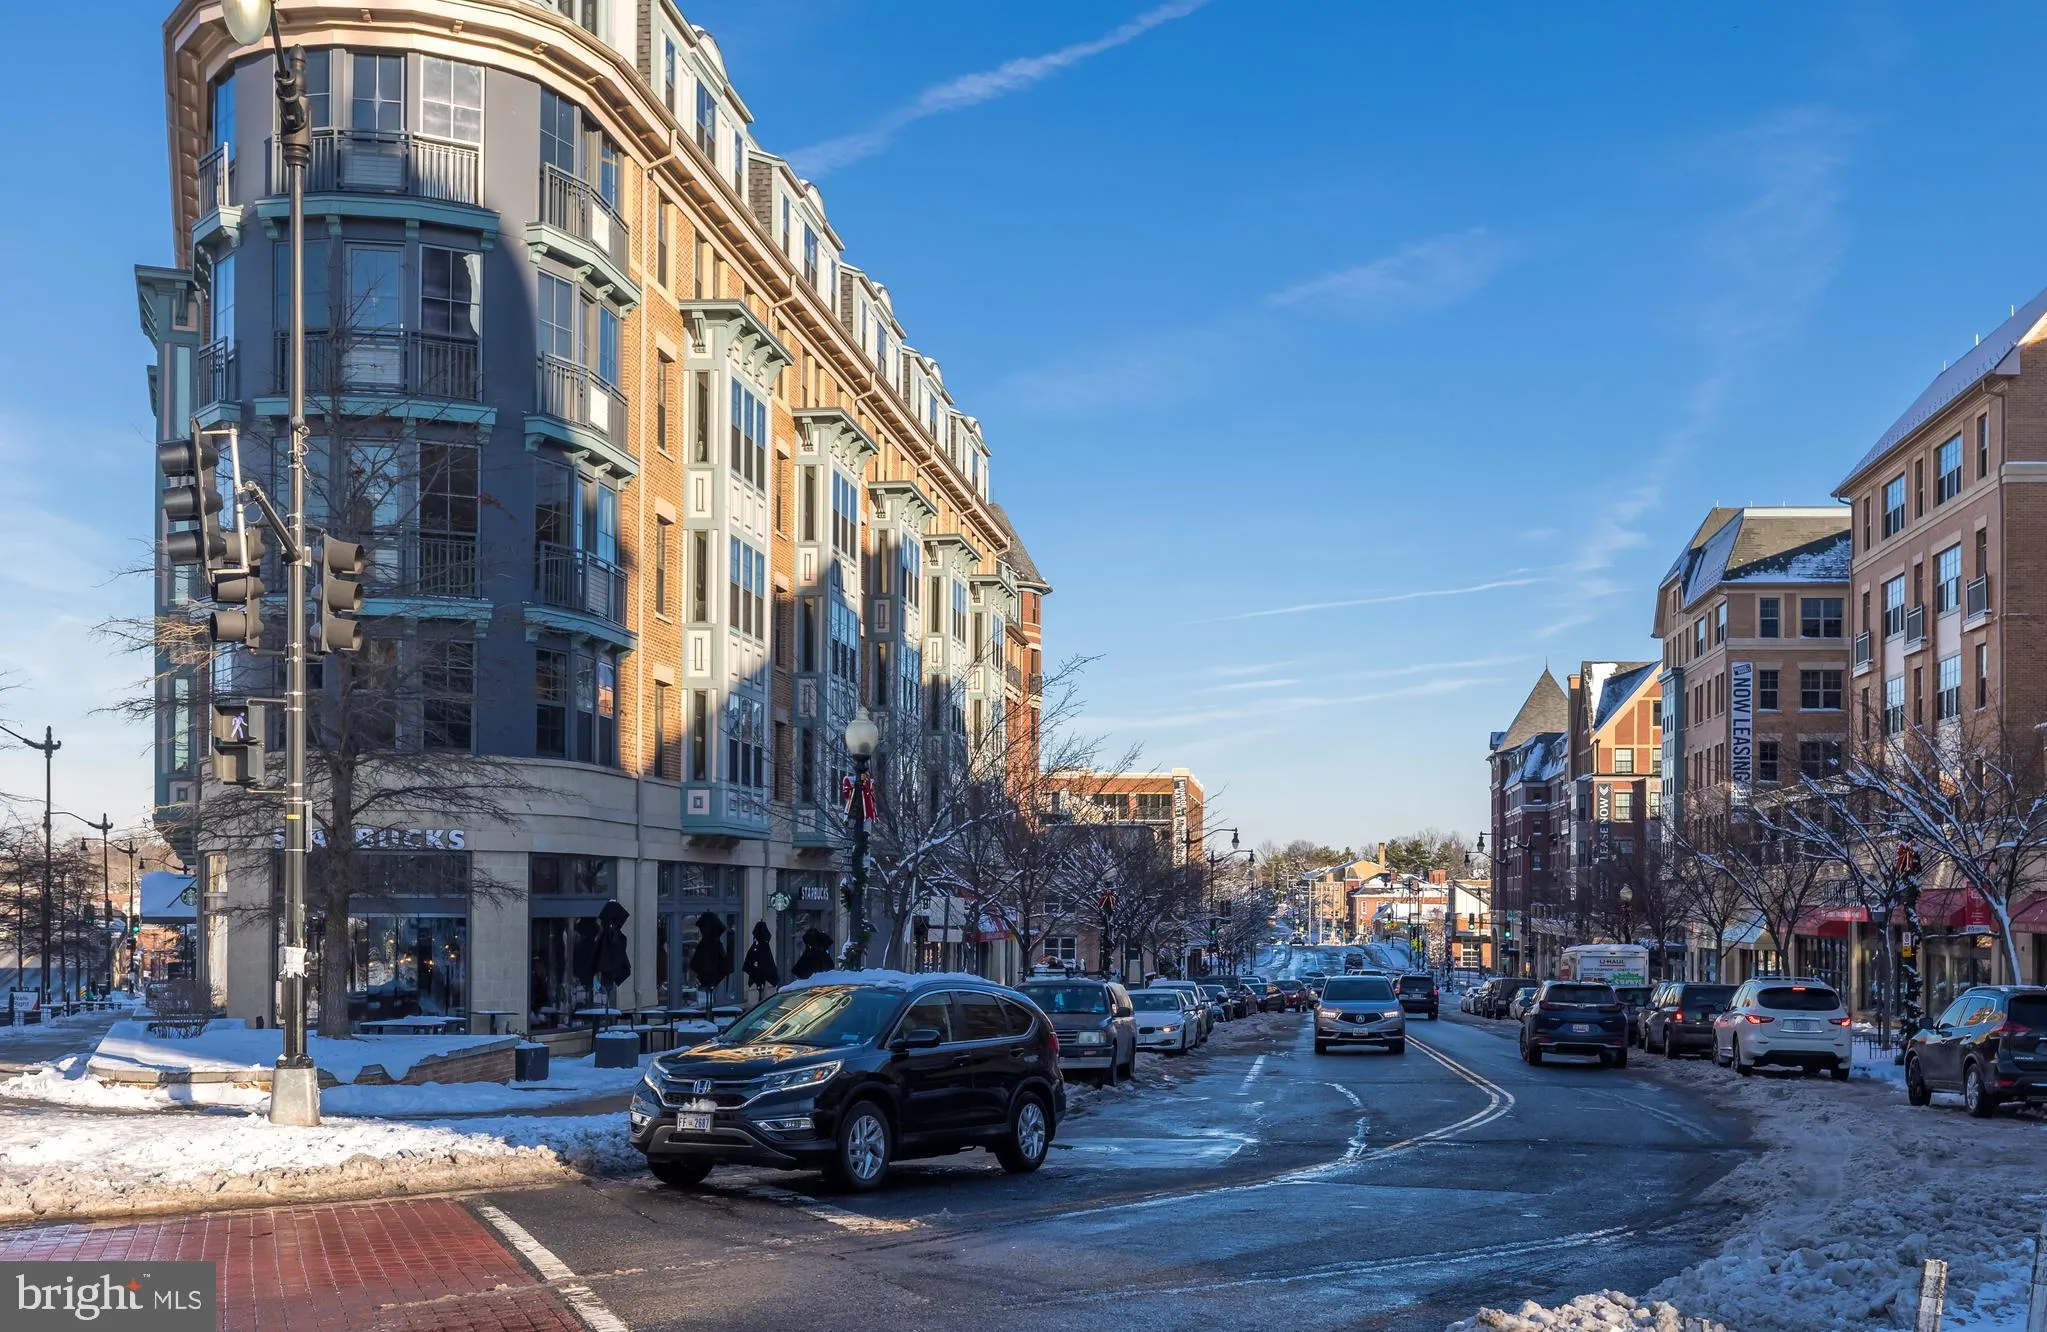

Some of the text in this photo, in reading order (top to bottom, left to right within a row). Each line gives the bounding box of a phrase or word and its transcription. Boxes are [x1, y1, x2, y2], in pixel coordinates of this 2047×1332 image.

[1732, 677, 1751, 713] NOW
[1732, 718, 1751, 782] LEASING
[273, 828, 465, 850] SABUCKS
[1600, 798, 1609, 860] LEASE NOW
[801, 886, 829, 900] STARBUCKS
